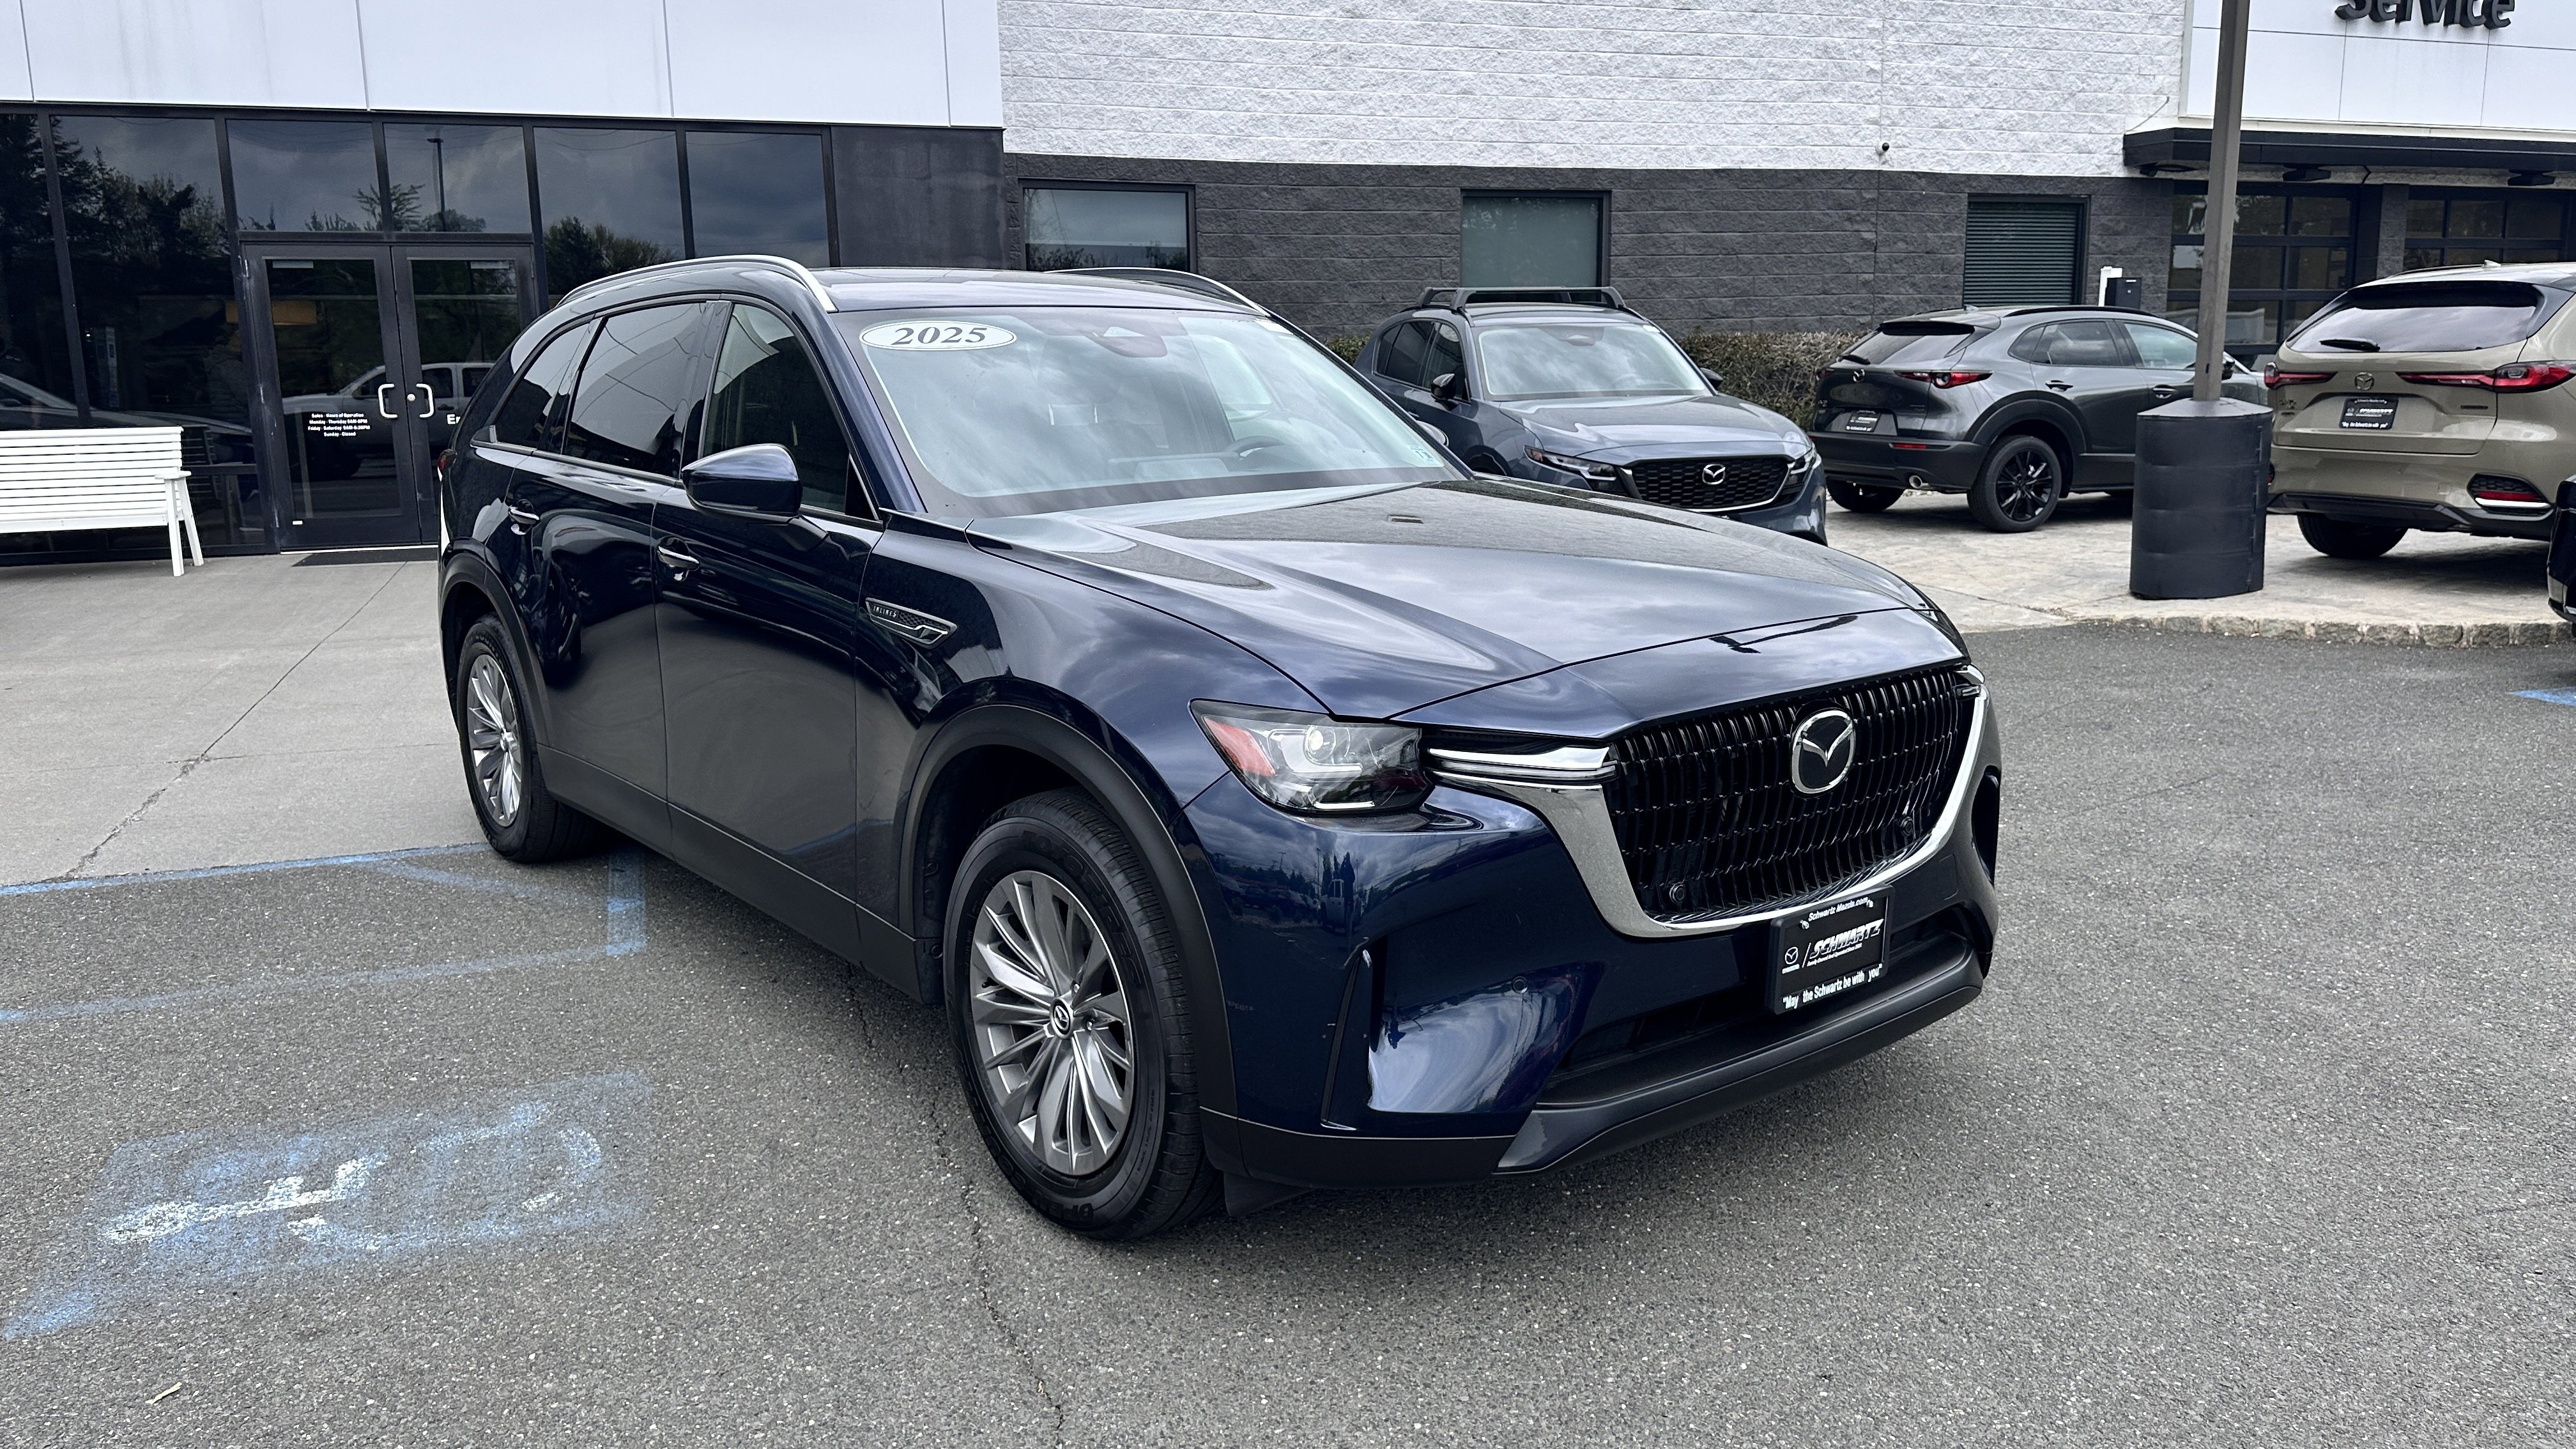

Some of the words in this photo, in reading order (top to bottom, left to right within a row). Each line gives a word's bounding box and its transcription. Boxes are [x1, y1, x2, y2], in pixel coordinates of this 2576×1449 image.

[891, 327, 988, 345] 2025
[1809, 919, 1884, 959] SCHWARTZ
[1802, 990, 1813, 1003] the
[1814, 981, 1843, 999] Schwartz
[1843, 976, 1851, 988] be
[1851, 970, 1865, 985] with
